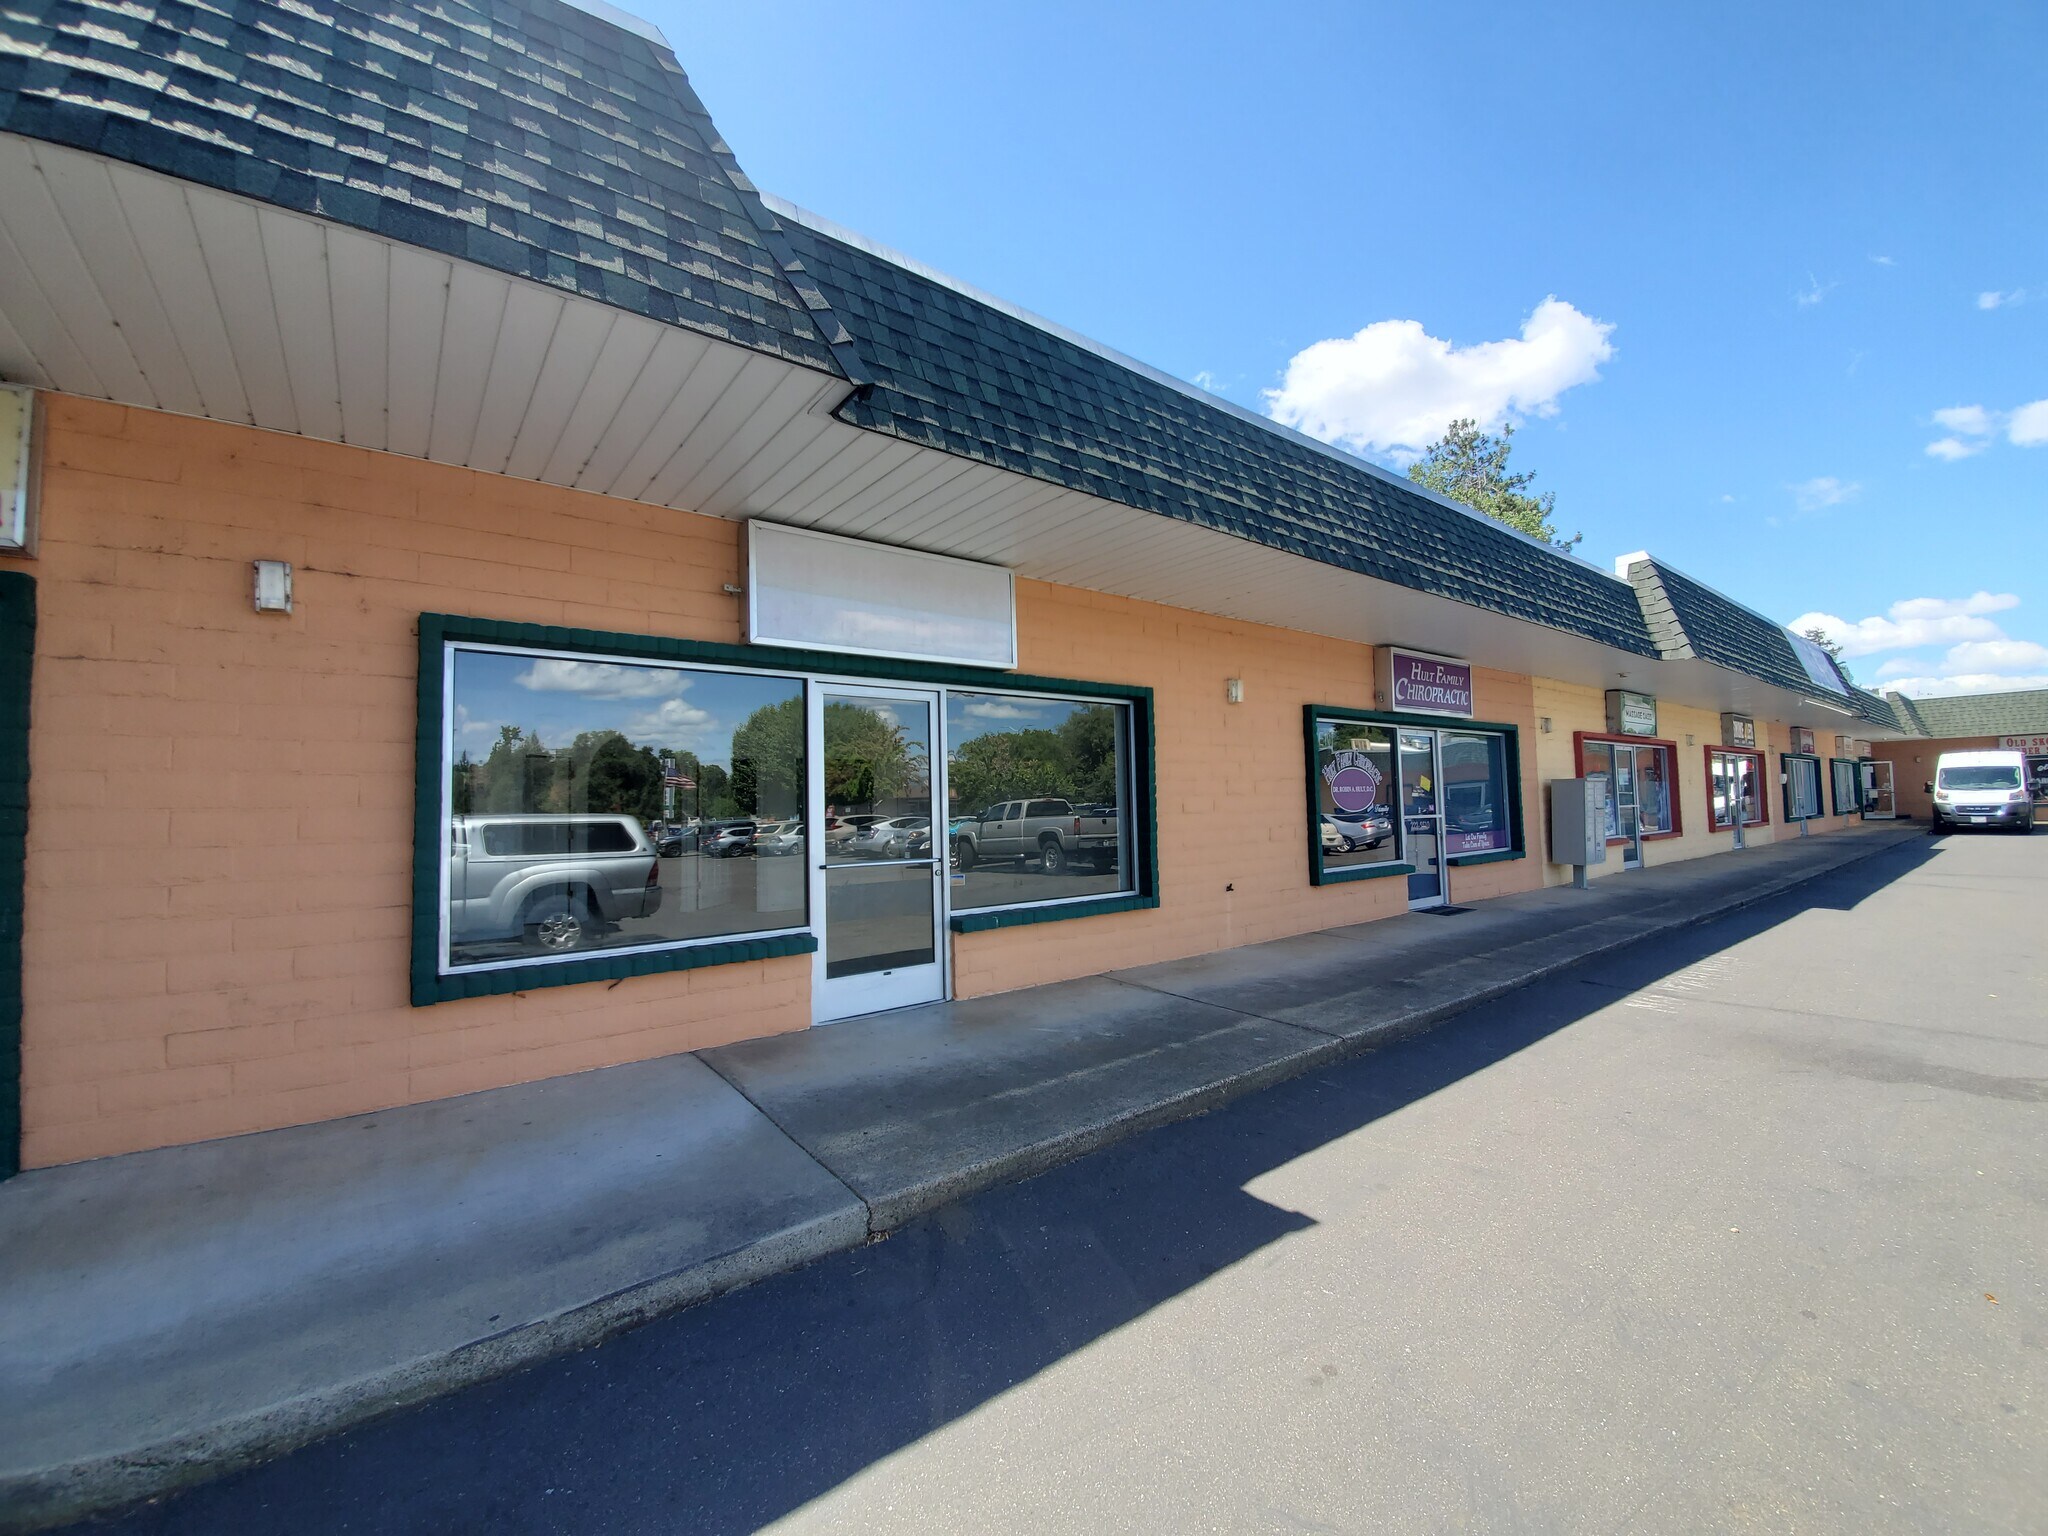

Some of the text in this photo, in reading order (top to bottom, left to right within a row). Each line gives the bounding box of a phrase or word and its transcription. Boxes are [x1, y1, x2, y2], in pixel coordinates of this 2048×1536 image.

[1411, 662, 1464, 686] HULT FAMILY
[1395, 677, 1469, 706] CHIROPRACTIC
